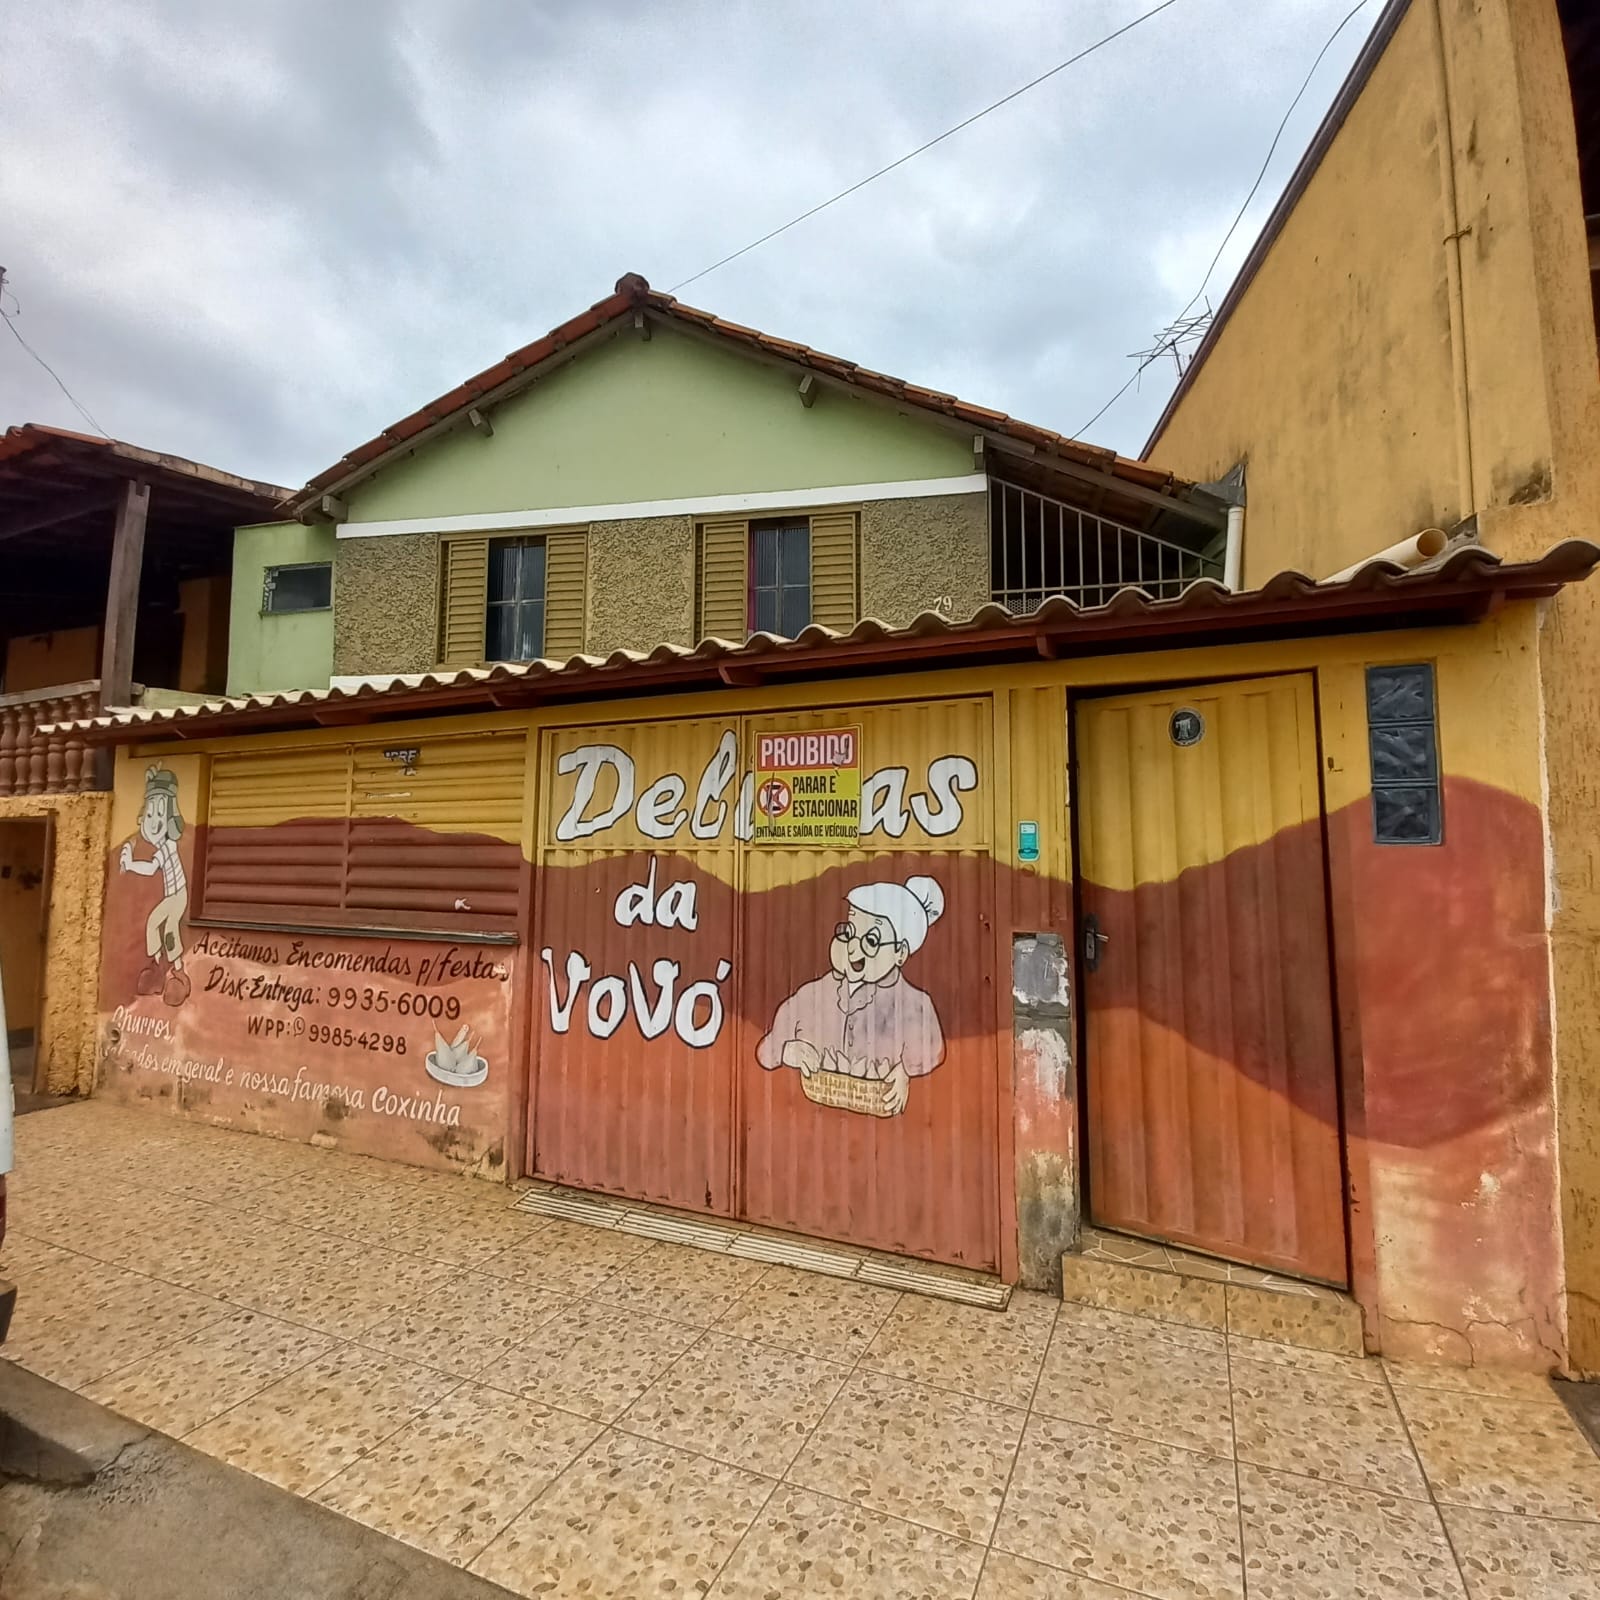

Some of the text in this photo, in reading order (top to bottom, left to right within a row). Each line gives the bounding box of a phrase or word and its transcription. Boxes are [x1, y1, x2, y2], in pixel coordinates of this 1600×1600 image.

[761, 733, 853, 768] PROIBIDO
[792, 775, 836, 794] PARAR E
[792, 799, 857, 818] ESTACIONAR
[756, 822, 858, 838] ENTRADA E SAÍDA DE VEÍCULOS
[614, 855, 698, 932] da
[286, 940, 412, 975] Encomendas
[248, 1015, 291, 1037] WPP:
[160, 1055, 183, 1076] em
[182, 1056, 224, 1083] geral
[225, 1067, 234, 1085] e
[239, 1070, 290, 1096] nossa
[371, 1086, 460, 1126] Coxinha
